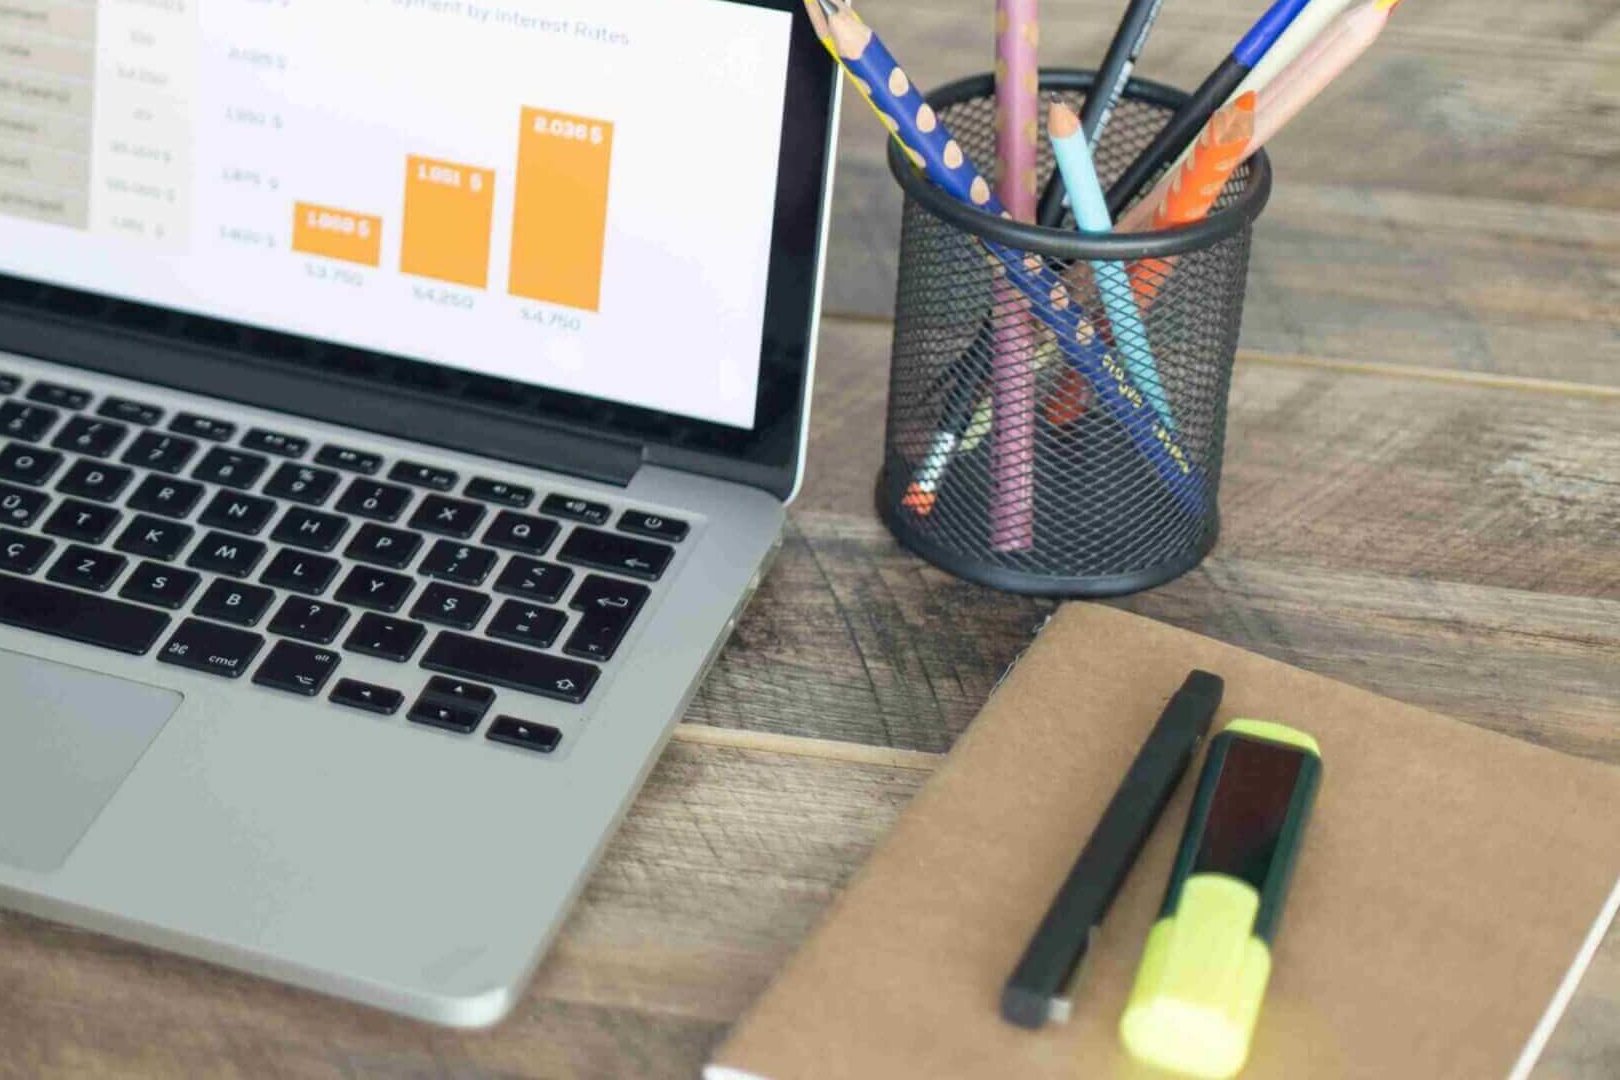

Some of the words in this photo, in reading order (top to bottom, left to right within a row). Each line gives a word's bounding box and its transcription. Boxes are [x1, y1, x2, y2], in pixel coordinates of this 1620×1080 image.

[467, 3, 491, 23] by
[574, 21, 631, 47] Rates
[589, 124, 604, 145] $
[86, 471, 105, 484] D
[157, 487, 175, 501] R
[228, 503, 248, 518] N
[77, 512, 92, 525] T
[300, 519, 321, 534] H
[144, 529, 164, 543] K
[375, 536, 392, 549] P
[215, 545, 237, 560] M
[77, 559, 97, 572] Z
[292, 562, 304, 576] L
[151, 576, 168, 589] S
[370, 579, 385, 593] Y
[225, 593, 242, 606] B
[208, 654, 239, 668] cmd
